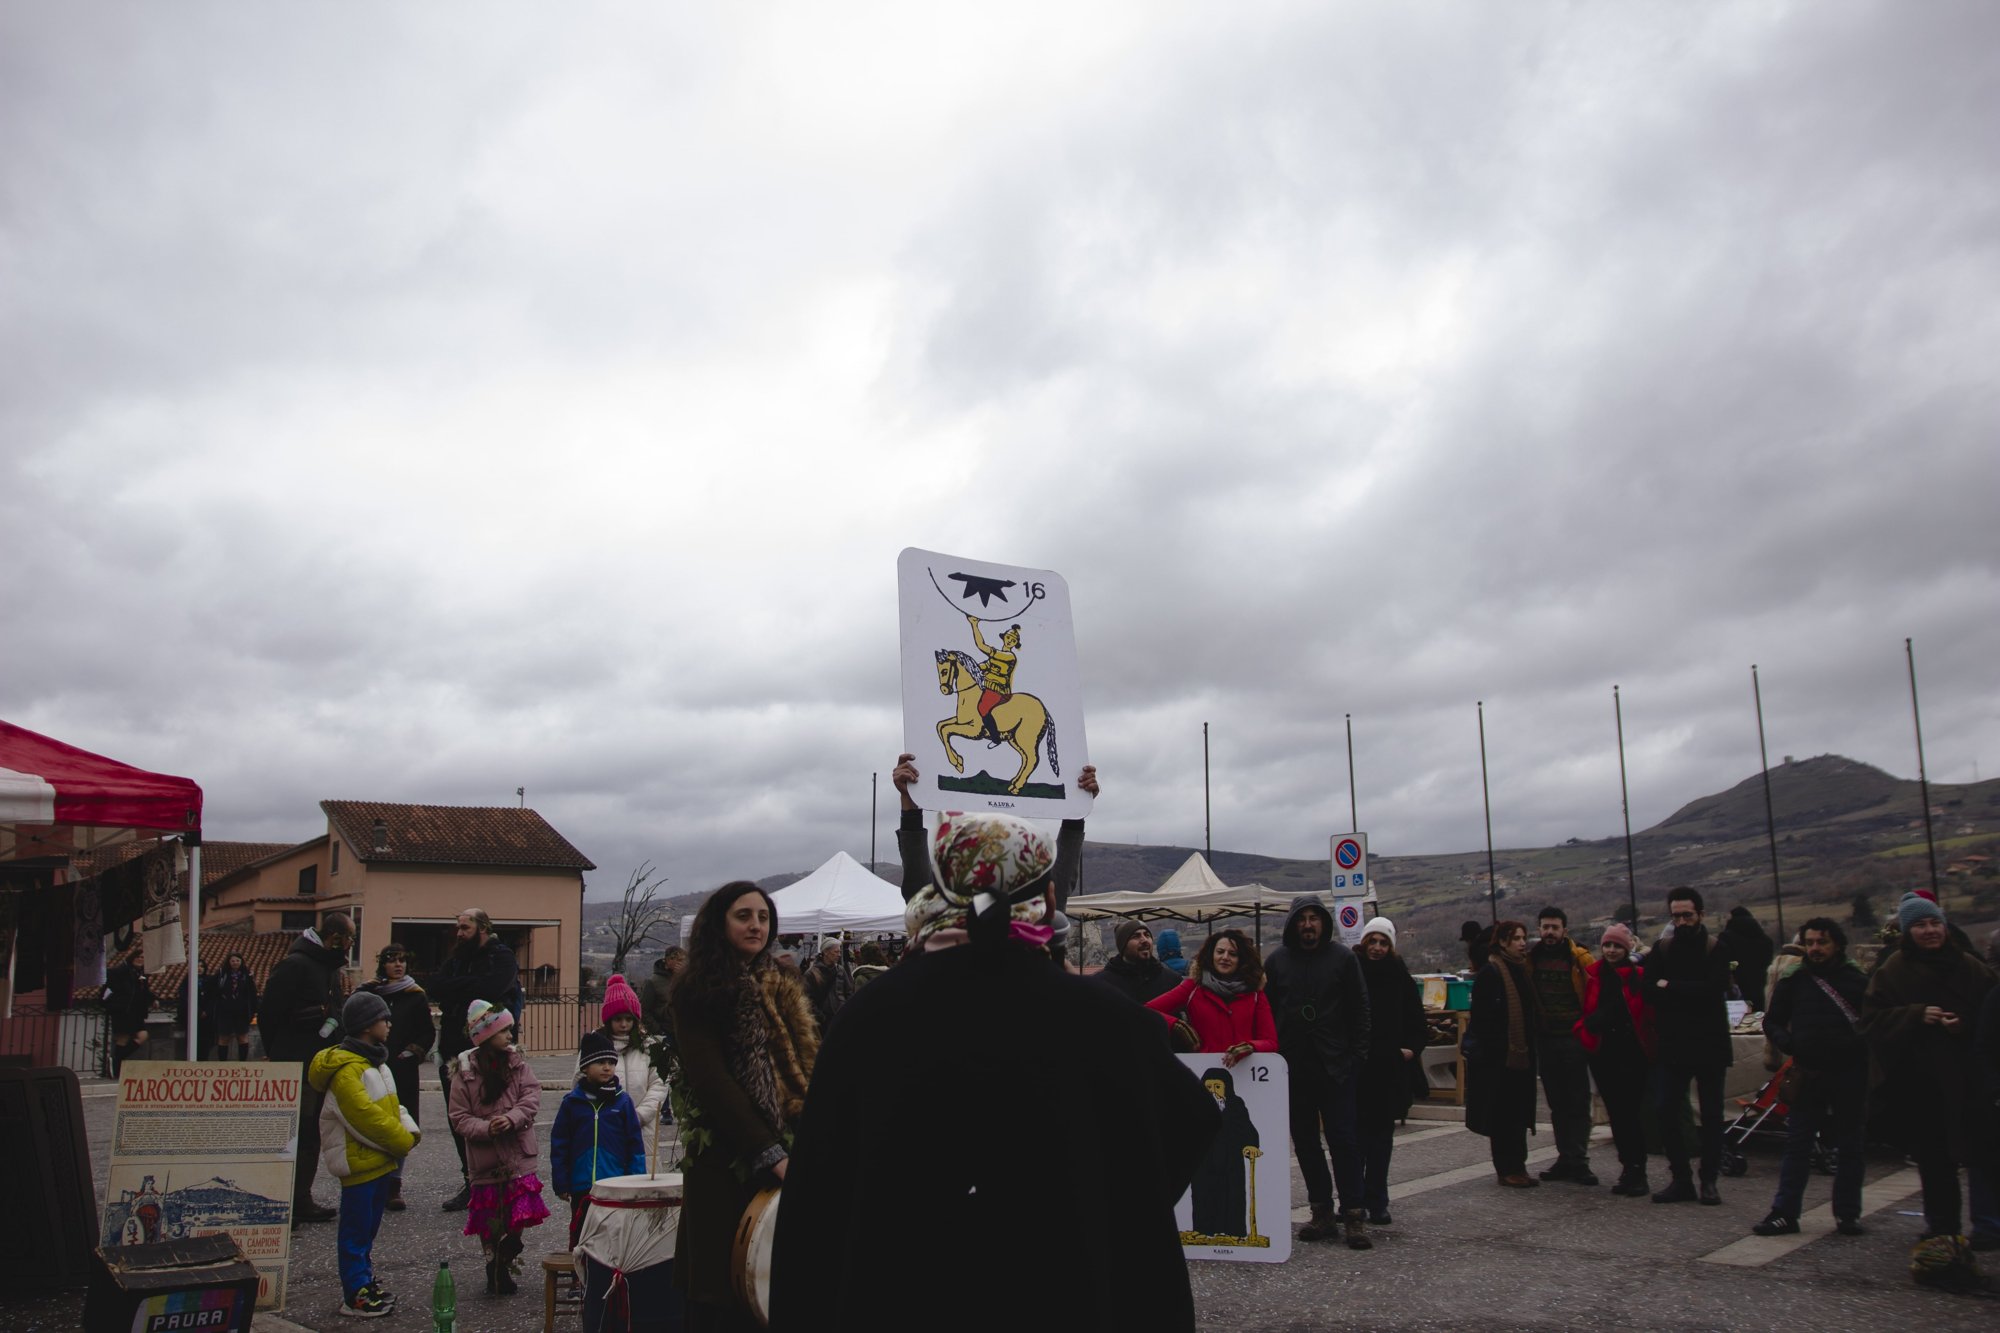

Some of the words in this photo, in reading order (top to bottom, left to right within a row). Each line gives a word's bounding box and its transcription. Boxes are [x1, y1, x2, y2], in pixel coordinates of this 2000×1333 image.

[1022, 581, 1046, 600] 16
[162, 1068, 214, 1078] JUOCO
[1250, 1066, 1269, 1081] 12
[124, 1079, 207, 1102] TAROCCU
[211, 1079, 299, 1101] SICILIANU
[247, 1237, 281, 1248] CAMPIONE
[153, 1310, 223, 1331] PAURA
